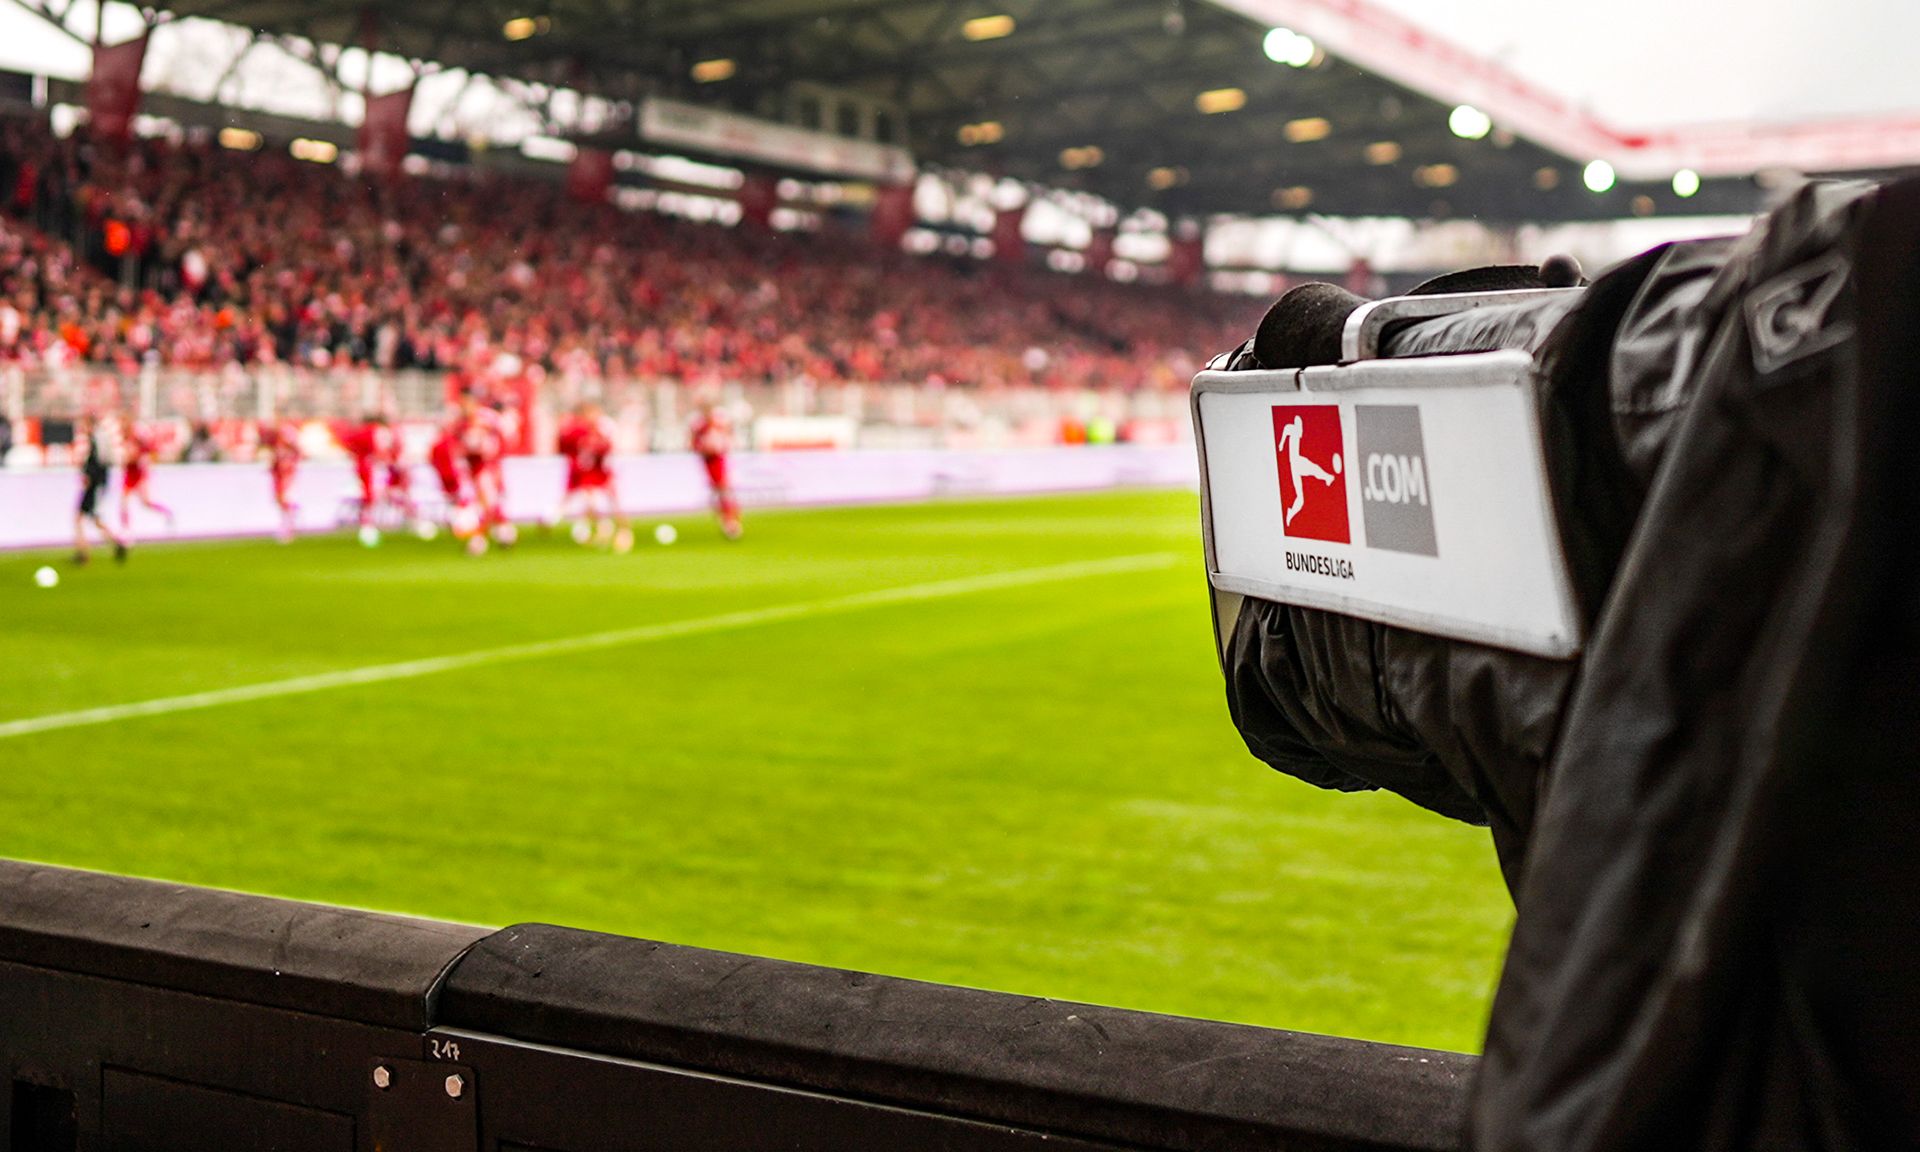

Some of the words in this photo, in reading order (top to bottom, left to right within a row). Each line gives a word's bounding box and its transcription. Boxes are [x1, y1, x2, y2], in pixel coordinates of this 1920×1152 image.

[1364, 452, 1428, 506] .COM
[1286, 551, 1355, 580] BUNDESLIGA
[431, 1039, 460, 1061] 217
